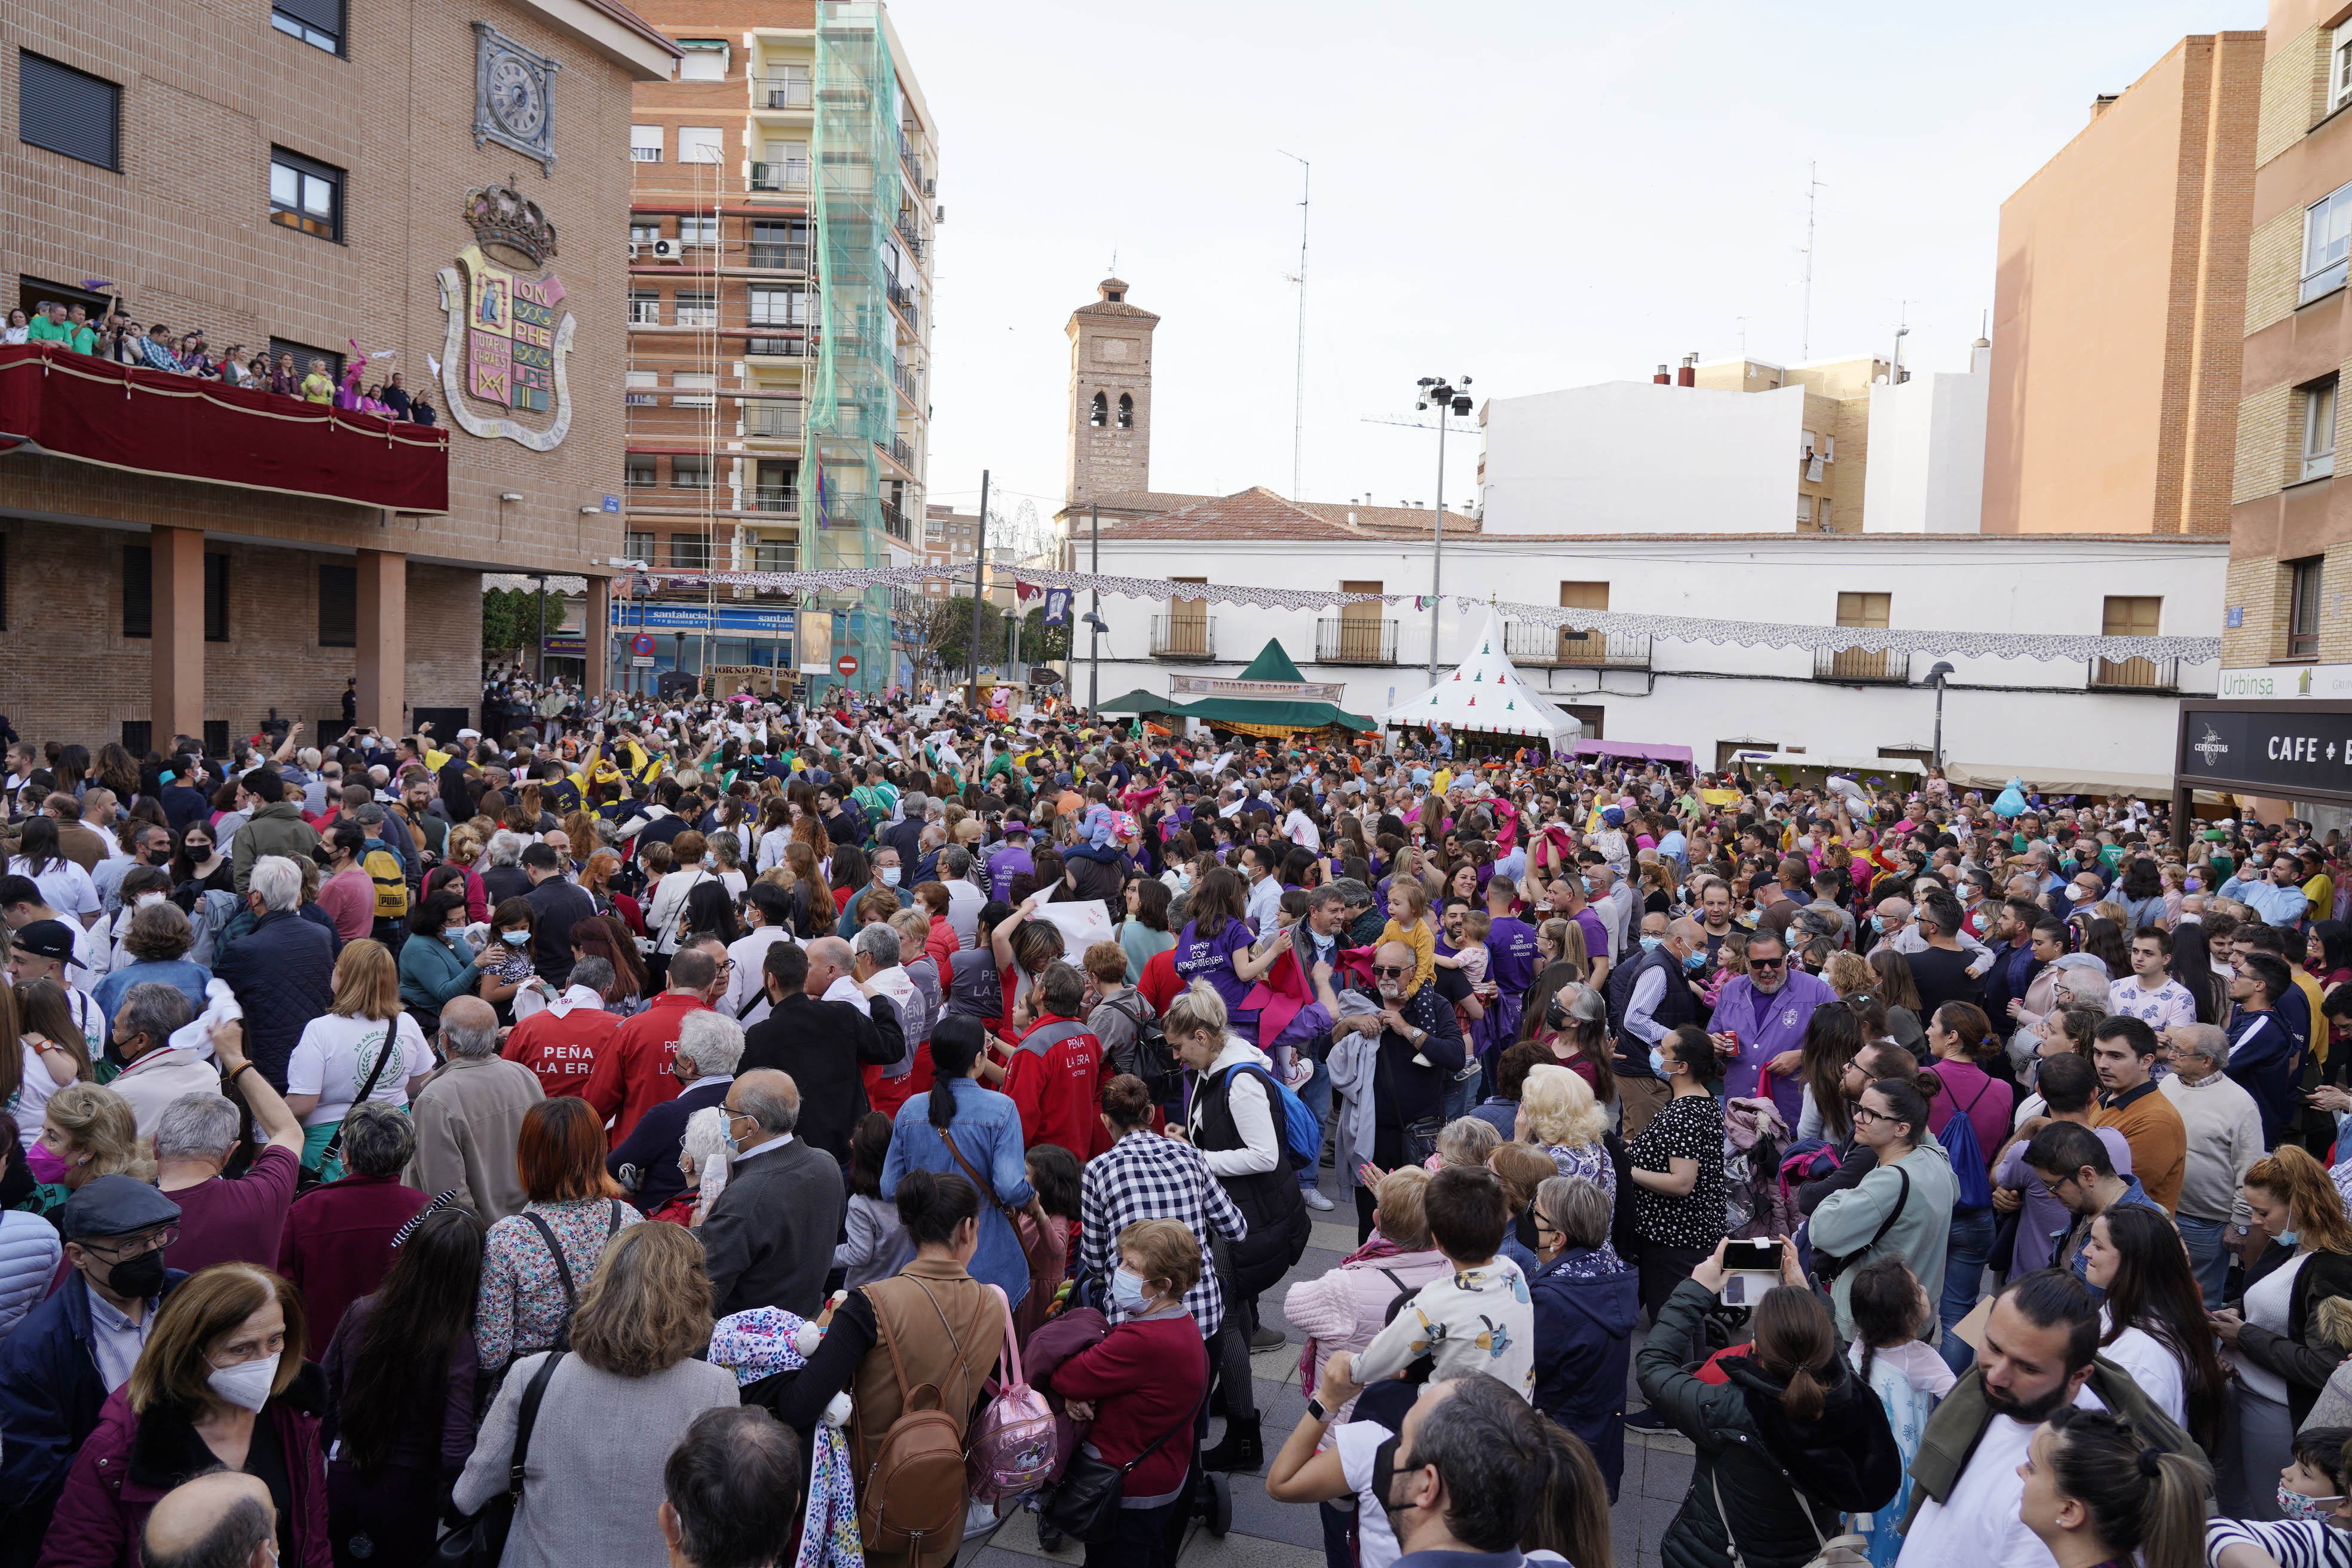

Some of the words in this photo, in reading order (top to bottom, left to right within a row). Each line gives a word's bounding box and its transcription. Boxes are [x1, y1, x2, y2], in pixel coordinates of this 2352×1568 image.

[520, 282, 547, 305] ON
[514, 321, 550, 347] PHE
[473, 333, 511, 354] TOTAPUL
[514, 365, 550, 389] LIPE
[653, 610, 708, 620] santalucía
[751, 666, 765, 675] DE
[1212, 681, 1255, 693] PATATAS
[1259, 684, 1299, 694] ASADAS
[2224, 673, 2273, 695] Urbinsa
[2194, 743, 2228, 754] CERVECISTAS
[2268, 736, 2319, 763] CAFE
[1192, 950, 1206, 959] LOS
[973, 986, 991, 997] LA
[901, 1000, 926, 1021] PEÑA
[354, 1043, 362, 1052] 20
[362, 1031, 379, 1043] AÑOS
[544, 1044, 594, 1059] PEÑA
[536, 1061, 558, 1074] LA
[1066, 1056, 1076, 1068] LA
[1077, 1053, 1091, 1065] ERA
[894, 1076, 902, 1085] LA
